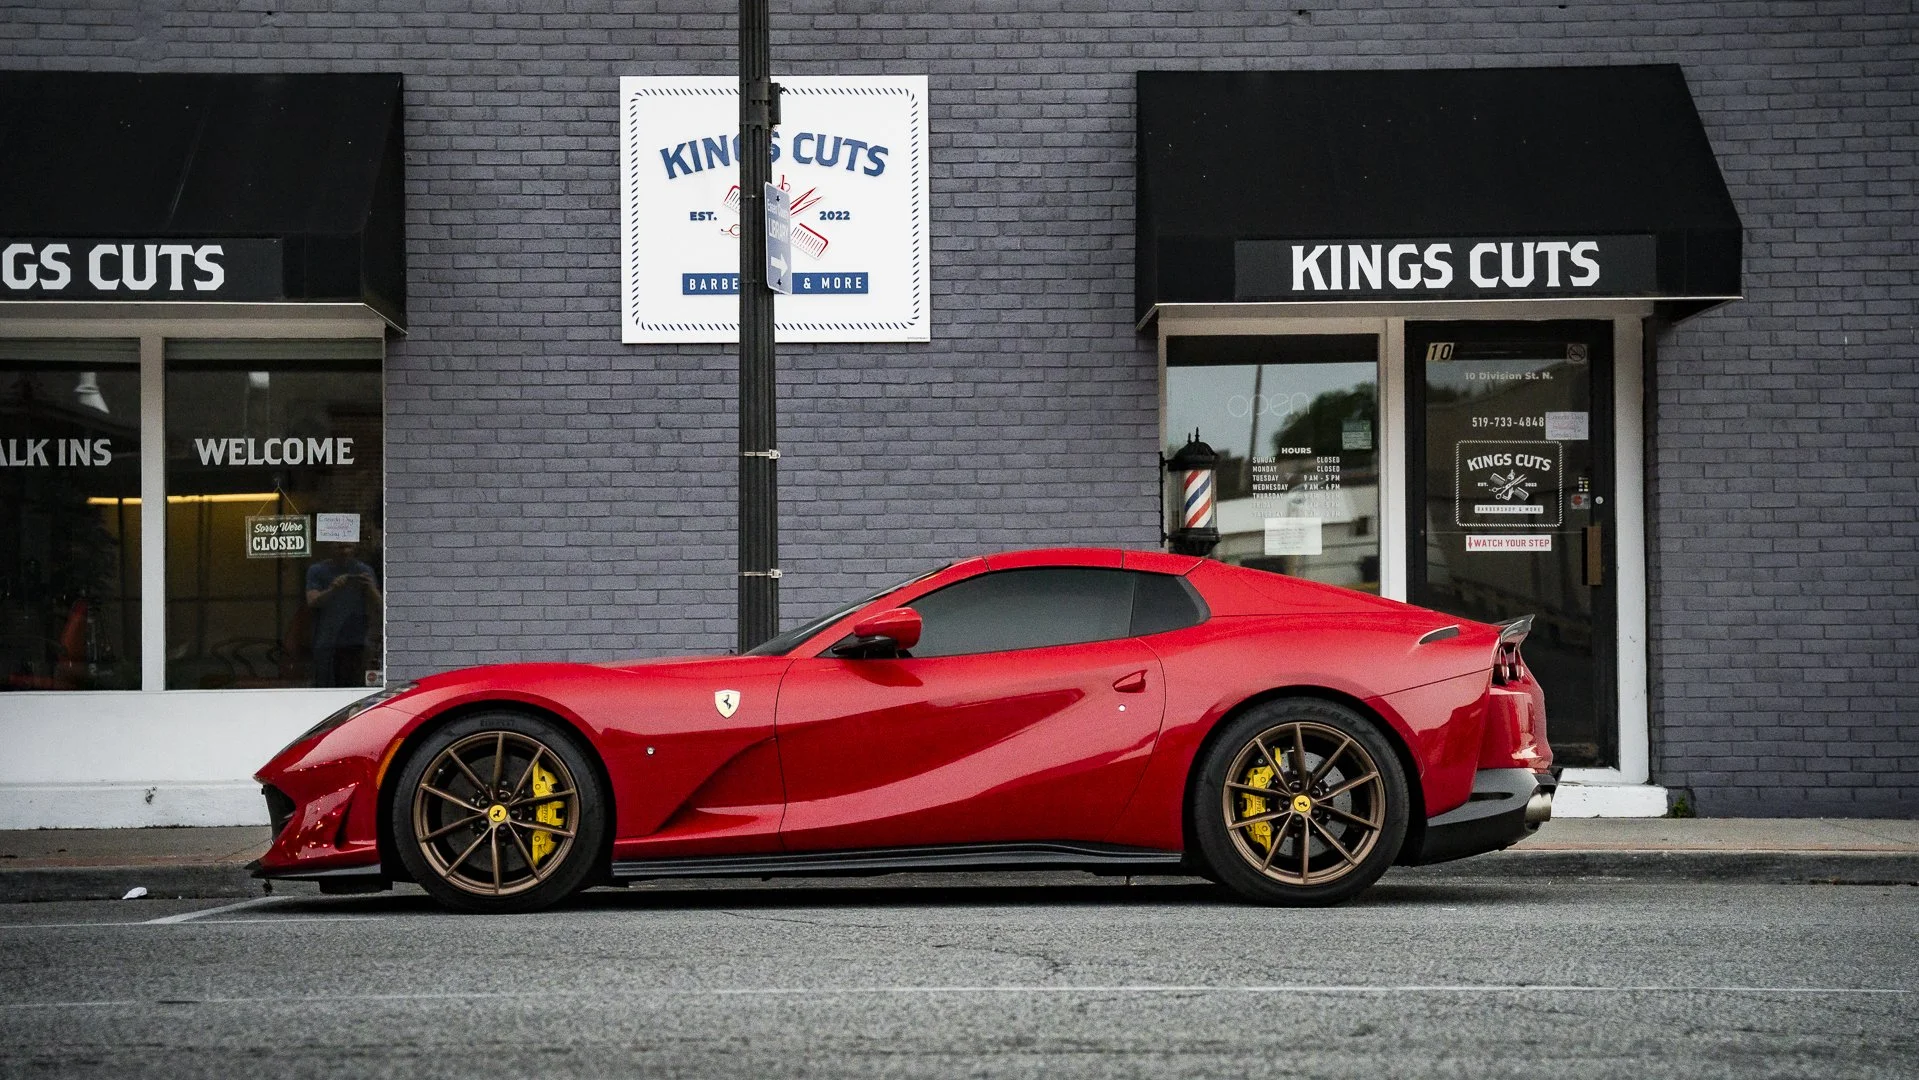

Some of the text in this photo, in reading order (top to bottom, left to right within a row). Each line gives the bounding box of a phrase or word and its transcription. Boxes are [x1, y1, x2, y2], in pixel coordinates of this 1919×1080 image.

[659, 131, 888, 179] KIN CUTS
[690, 211, 851, 221] EST. 2022
[2, 243, 225, 291] GS CUTS
[1292, 241, 1600, 290] KINGS CUTS
[690, 277, 862, 290] BARBE & MORE
[1431, 343, 1452, 361] 10
[1480, 371, 1522, 380] Division
[1525, 371, 1539, 380] St.
[1542, 371, 1554, 380] N.
[1227, 392, 1311, 423] open
[1472, 416, 1545, 428] 519-733-4848
[58, 438, 112, 467] INS
[194, 437, 355, 466] WELCOME
[1252, 456, 1341, 464] SUNDAY CLOSED
[1467, 454, 1552, 471] KINGS CUTS
[1252, 465, 1341, 473] MONDAY CLOSED
[1252, 474, 1279, 482] TUESDAY
[1309, 474, 1319, 482] AM
[1331, 474, 1341, 482] PM
[1252, 483, 1289, 491] WEDNESDAY
[1309, 483, 1319, 491] AM
[1331, 483, 1341, 491] PM
[254, 522, 303, 535] Sorry Were
[252, 536, 305, 551] CLOSED
[1474, 539, 1550, 547] WATCH YOUR STEP
